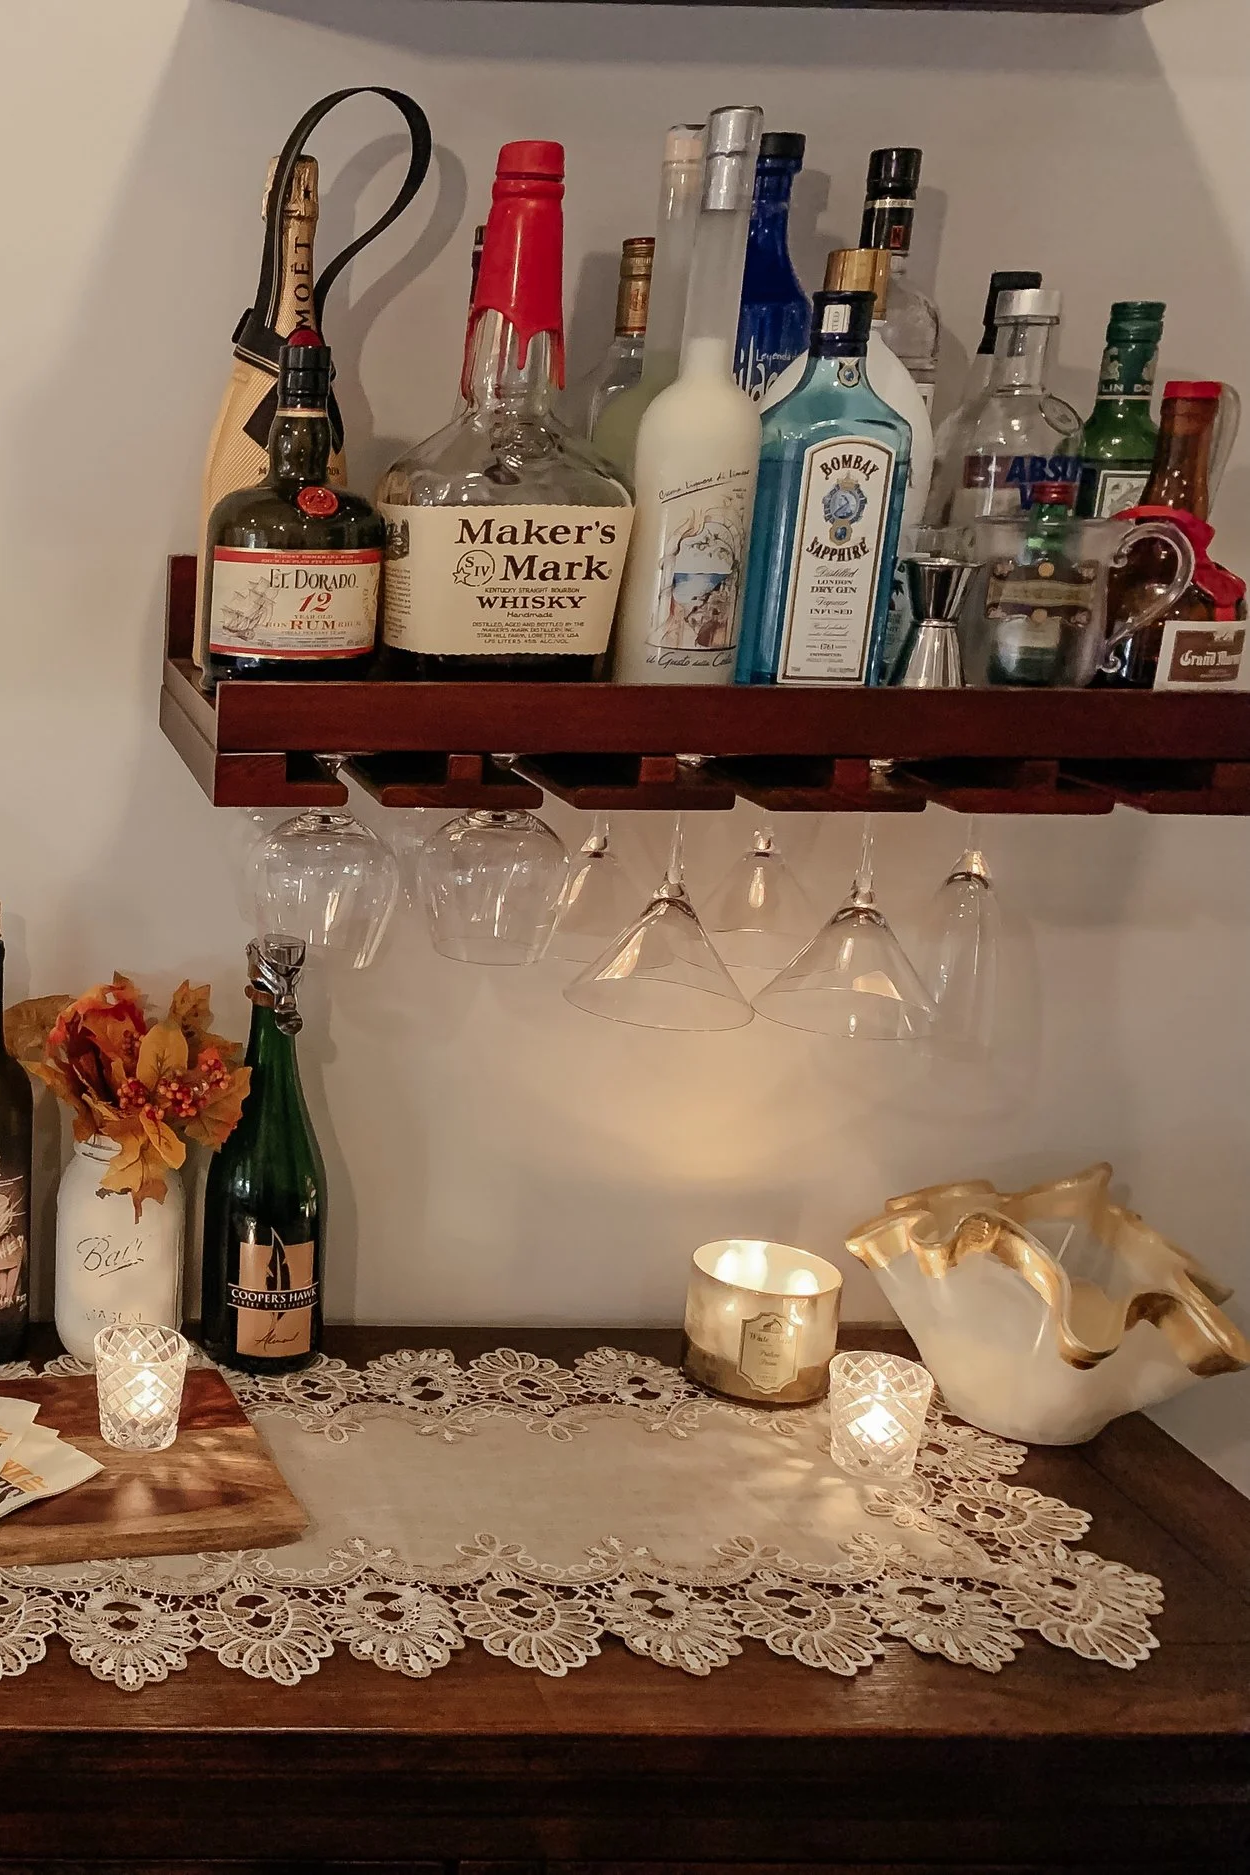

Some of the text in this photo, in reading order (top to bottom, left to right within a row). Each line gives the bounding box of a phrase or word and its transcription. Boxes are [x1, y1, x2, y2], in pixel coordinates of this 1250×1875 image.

[293, 237, 311, 329] MOËT
[819, 454, 880, 481] BOMBAY
[454, 518, 616, 545] Maker's
[806, 536, 870, 562] SAPPHIRE
[270, 568, 291, 588] EL
[499, 554, 611, 581] Mark
[299, 592, 332, 612] 12
[476, 595, 587, 609] WHISKY
[290, 620, 335, 630] RUM
[76, 1235, 143, 1271] Ball
[231, 1286, 317, 1304] COOPER'S HAWK
